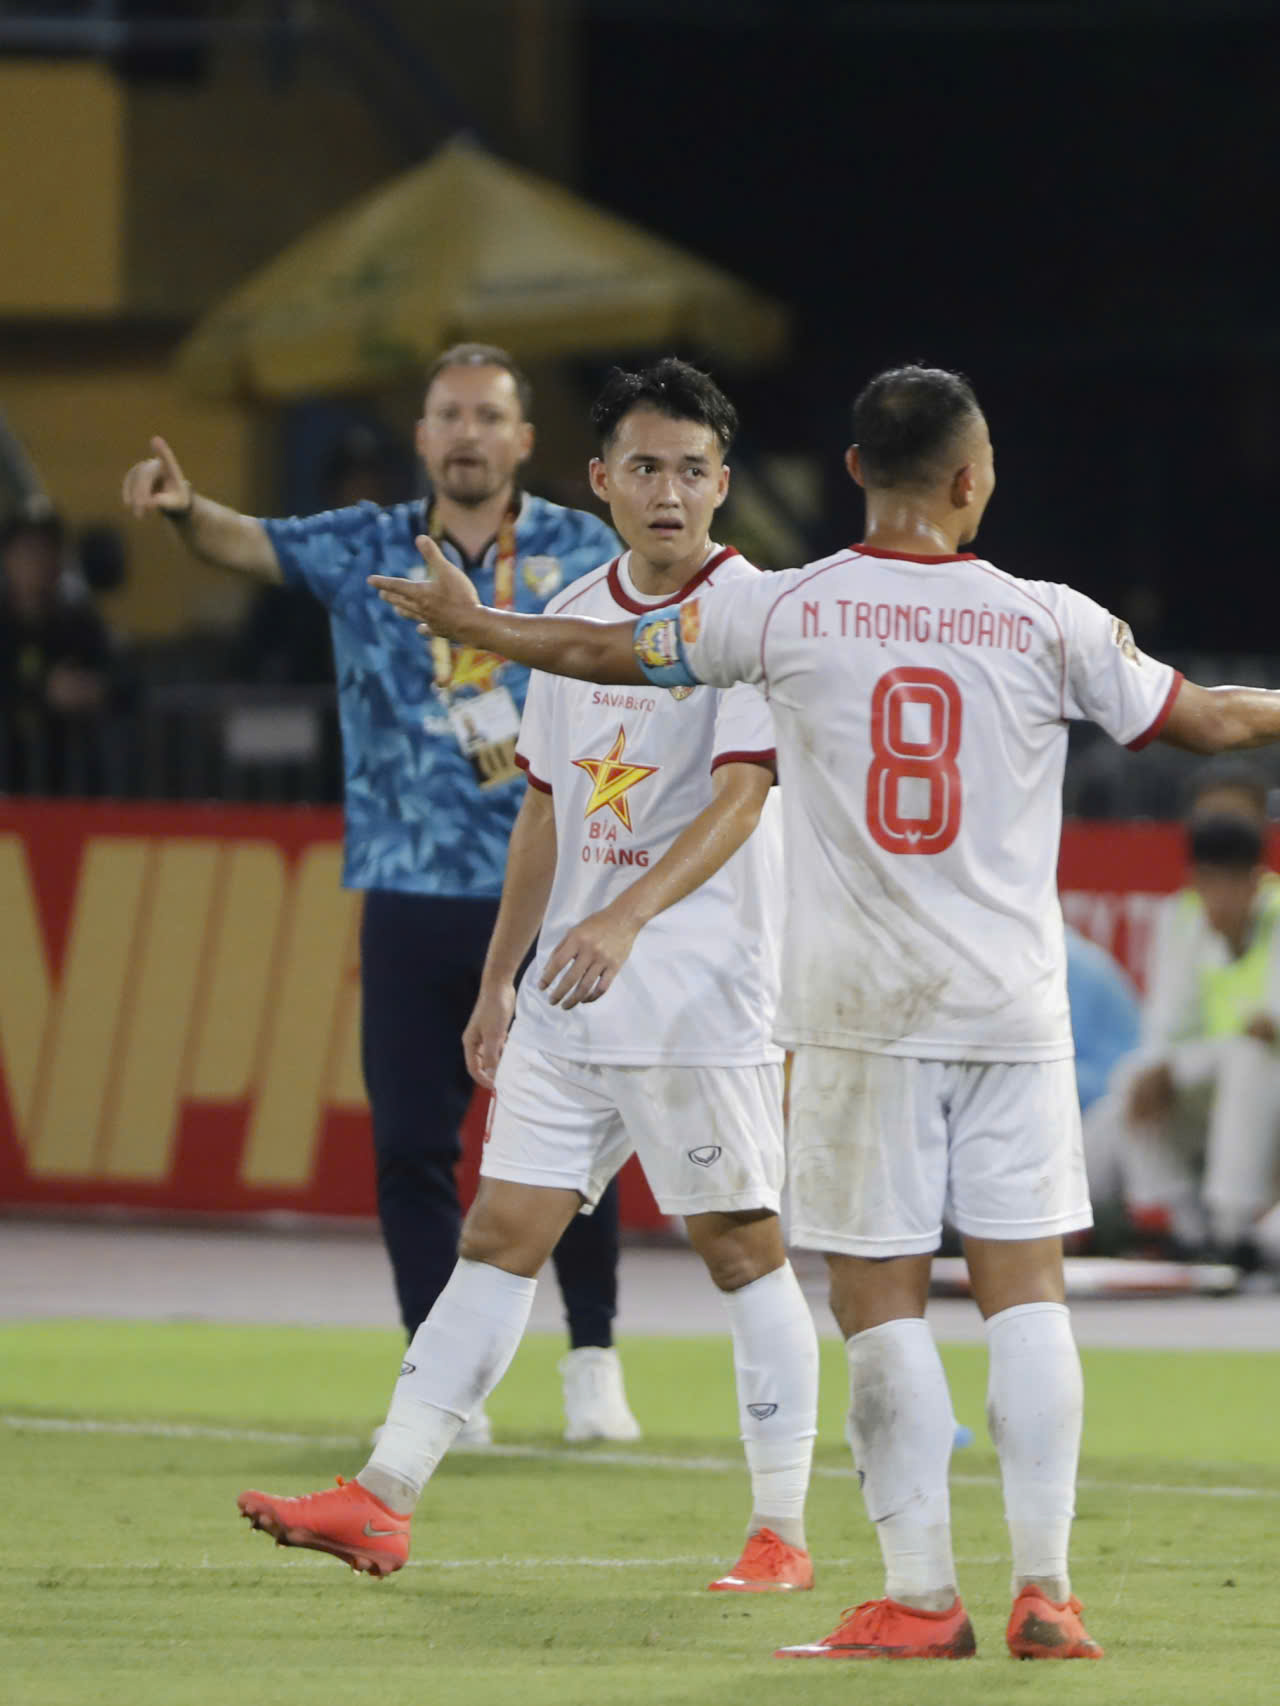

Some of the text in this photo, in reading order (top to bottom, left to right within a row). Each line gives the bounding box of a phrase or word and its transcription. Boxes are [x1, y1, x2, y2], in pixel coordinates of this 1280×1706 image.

[802, 599, 1034, 653] N. TRỌNG HOÀNG
[865, 666, 963, 855] 8
